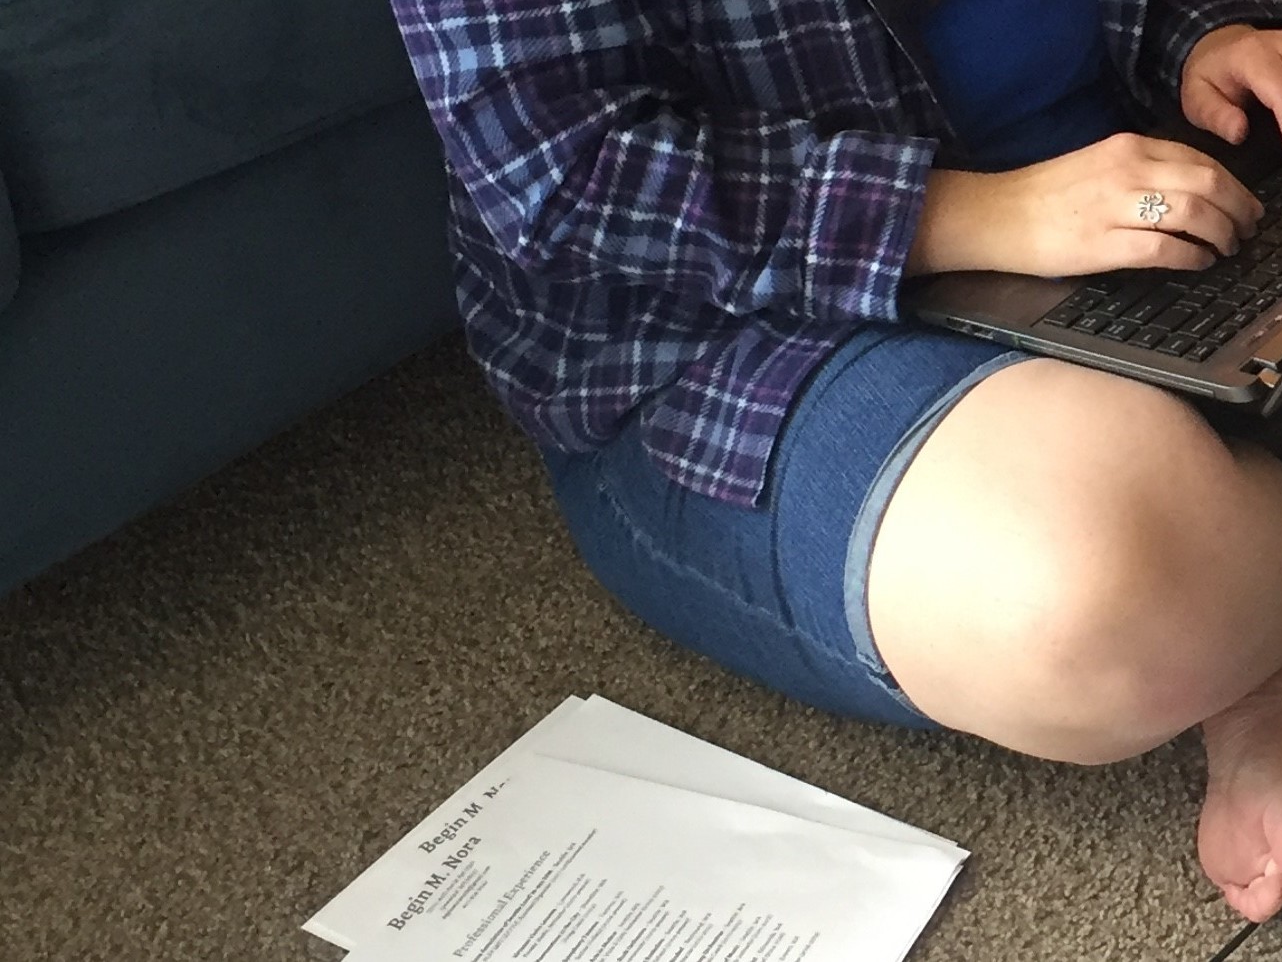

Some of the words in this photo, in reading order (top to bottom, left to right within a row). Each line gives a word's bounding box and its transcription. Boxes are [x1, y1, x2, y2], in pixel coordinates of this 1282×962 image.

[418, 814, 468, 854] Begin
[386, 887, 434, 931] Begin
[441, 835, 482, 870] Nora
[453, 898, 506, 958] Professional
[503, 849, 551, 902] Experience
